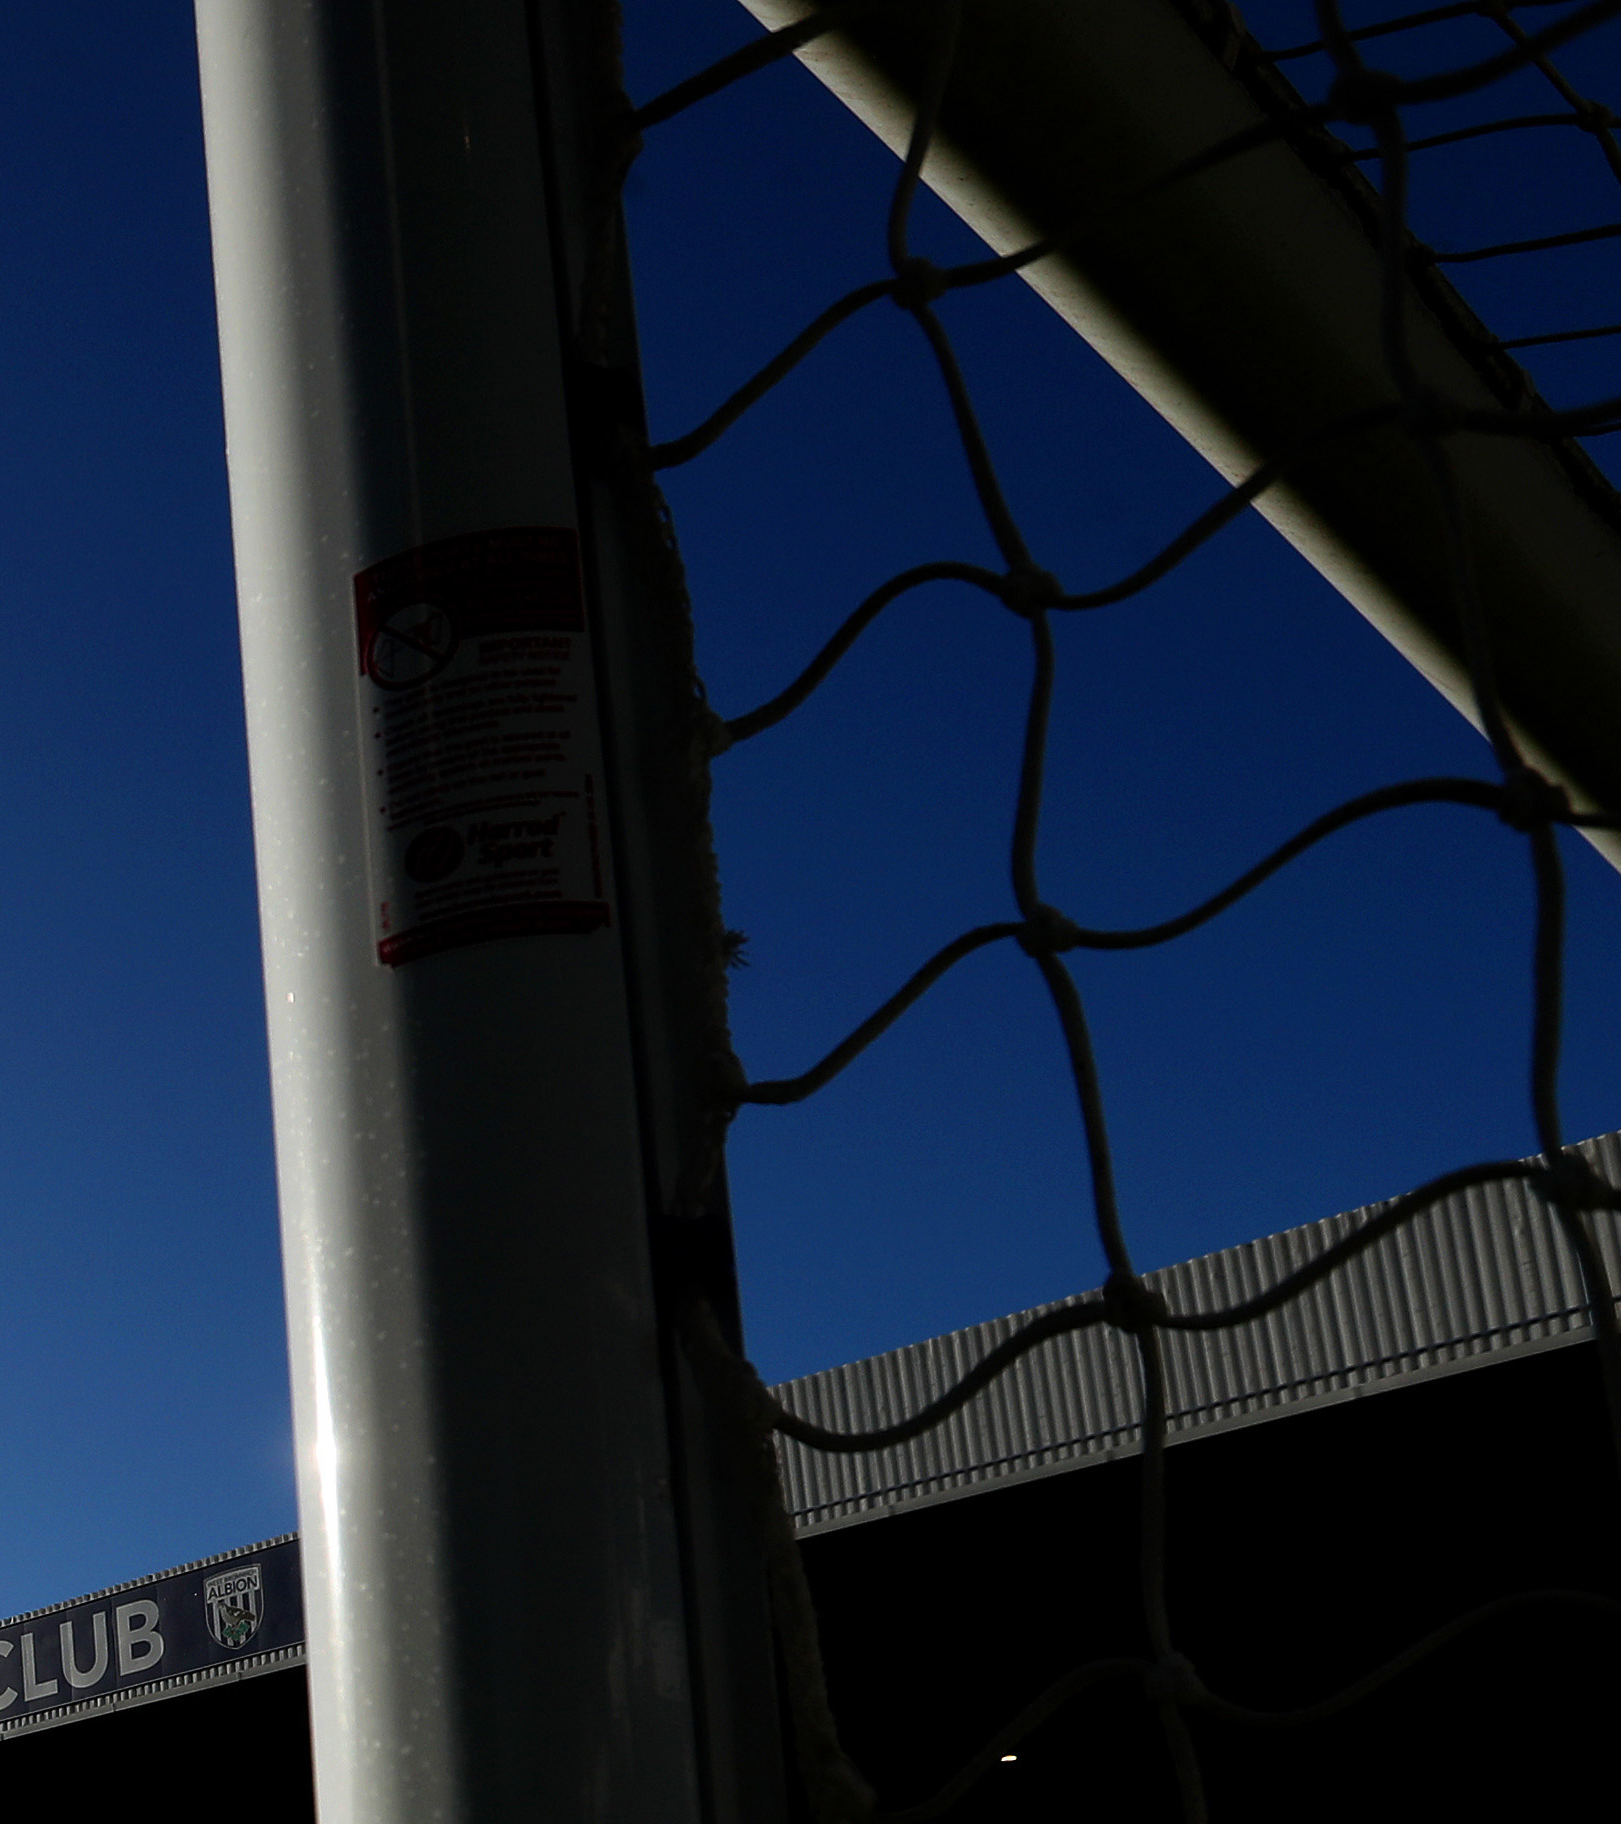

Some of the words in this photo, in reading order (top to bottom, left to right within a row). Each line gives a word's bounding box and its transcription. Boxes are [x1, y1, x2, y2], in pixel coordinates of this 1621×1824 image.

[467, 814, 559, 844] Harrod
[478, 838, 553, 867] Sport
[208, 1575, 257, 1600] ALBION
